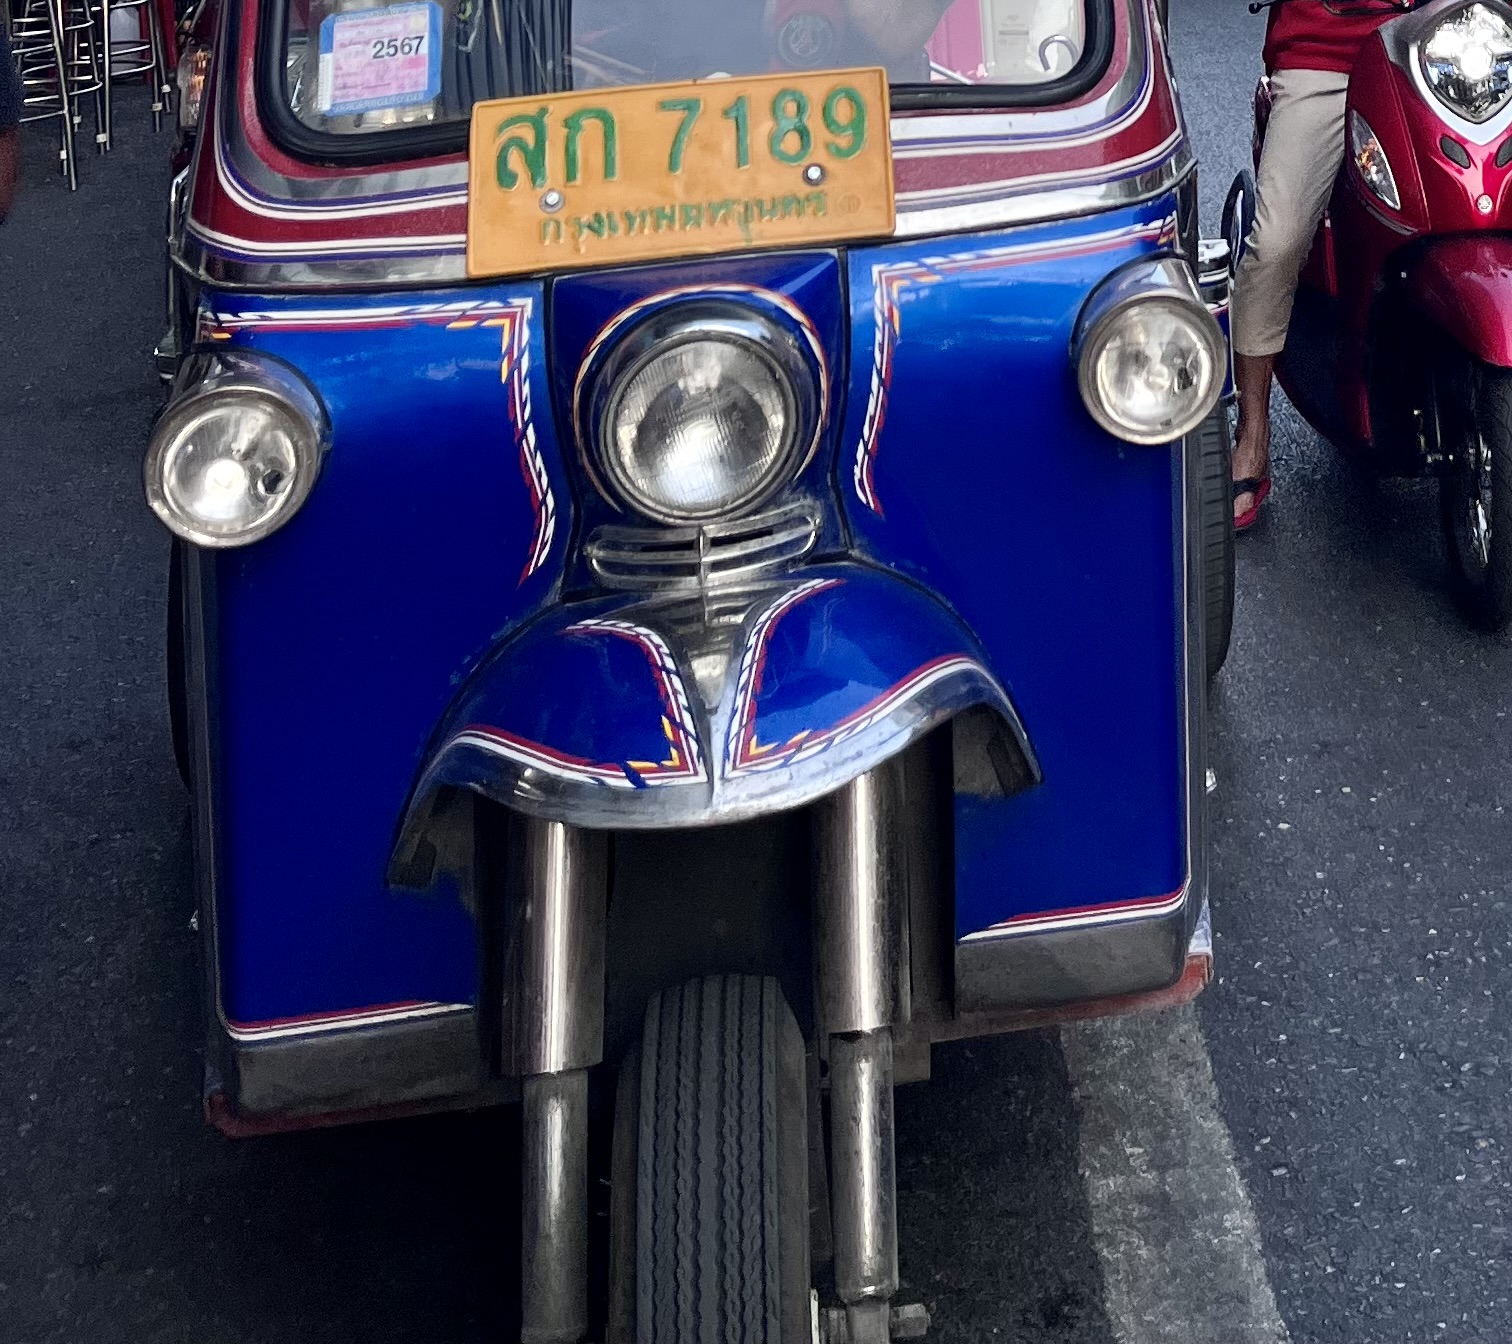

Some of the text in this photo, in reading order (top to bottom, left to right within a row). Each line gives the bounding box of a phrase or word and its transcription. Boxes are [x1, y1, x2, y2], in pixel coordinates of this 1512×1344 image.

[372, 35, 425, 60] 2567
[495, 86, 868, 192] สก 7189
